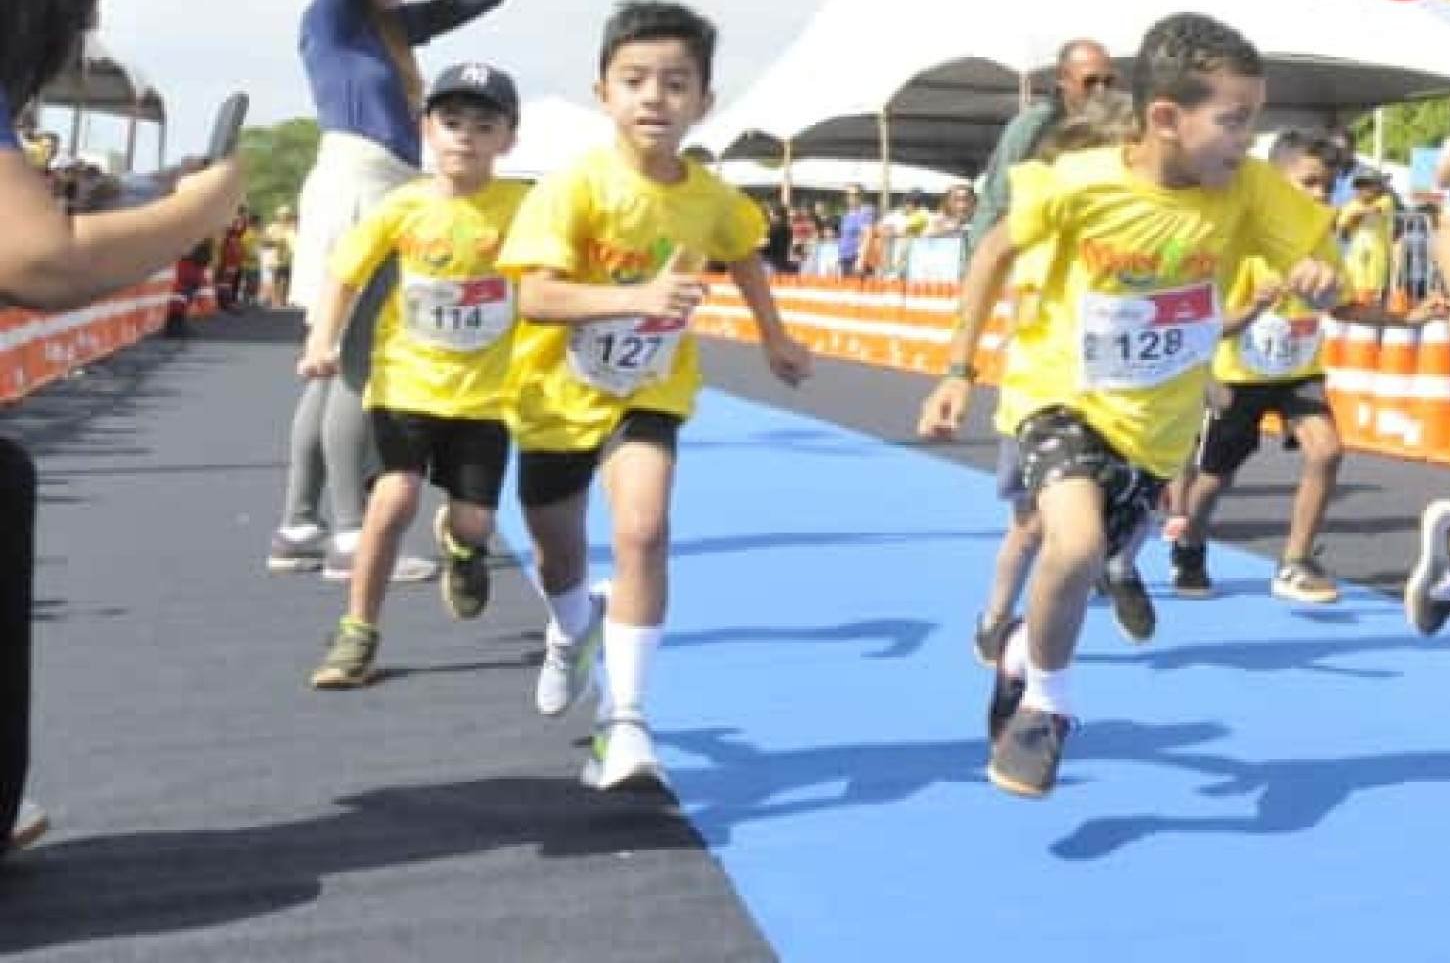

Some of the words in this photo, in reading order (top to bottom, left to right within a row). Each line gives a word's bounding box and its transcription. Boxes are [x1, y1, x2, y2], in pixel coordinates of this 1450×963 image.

[430, 305, 482, 330] 114
[597, 333, 662, 368] 127
[1114, 328, 1184, 361] 128
